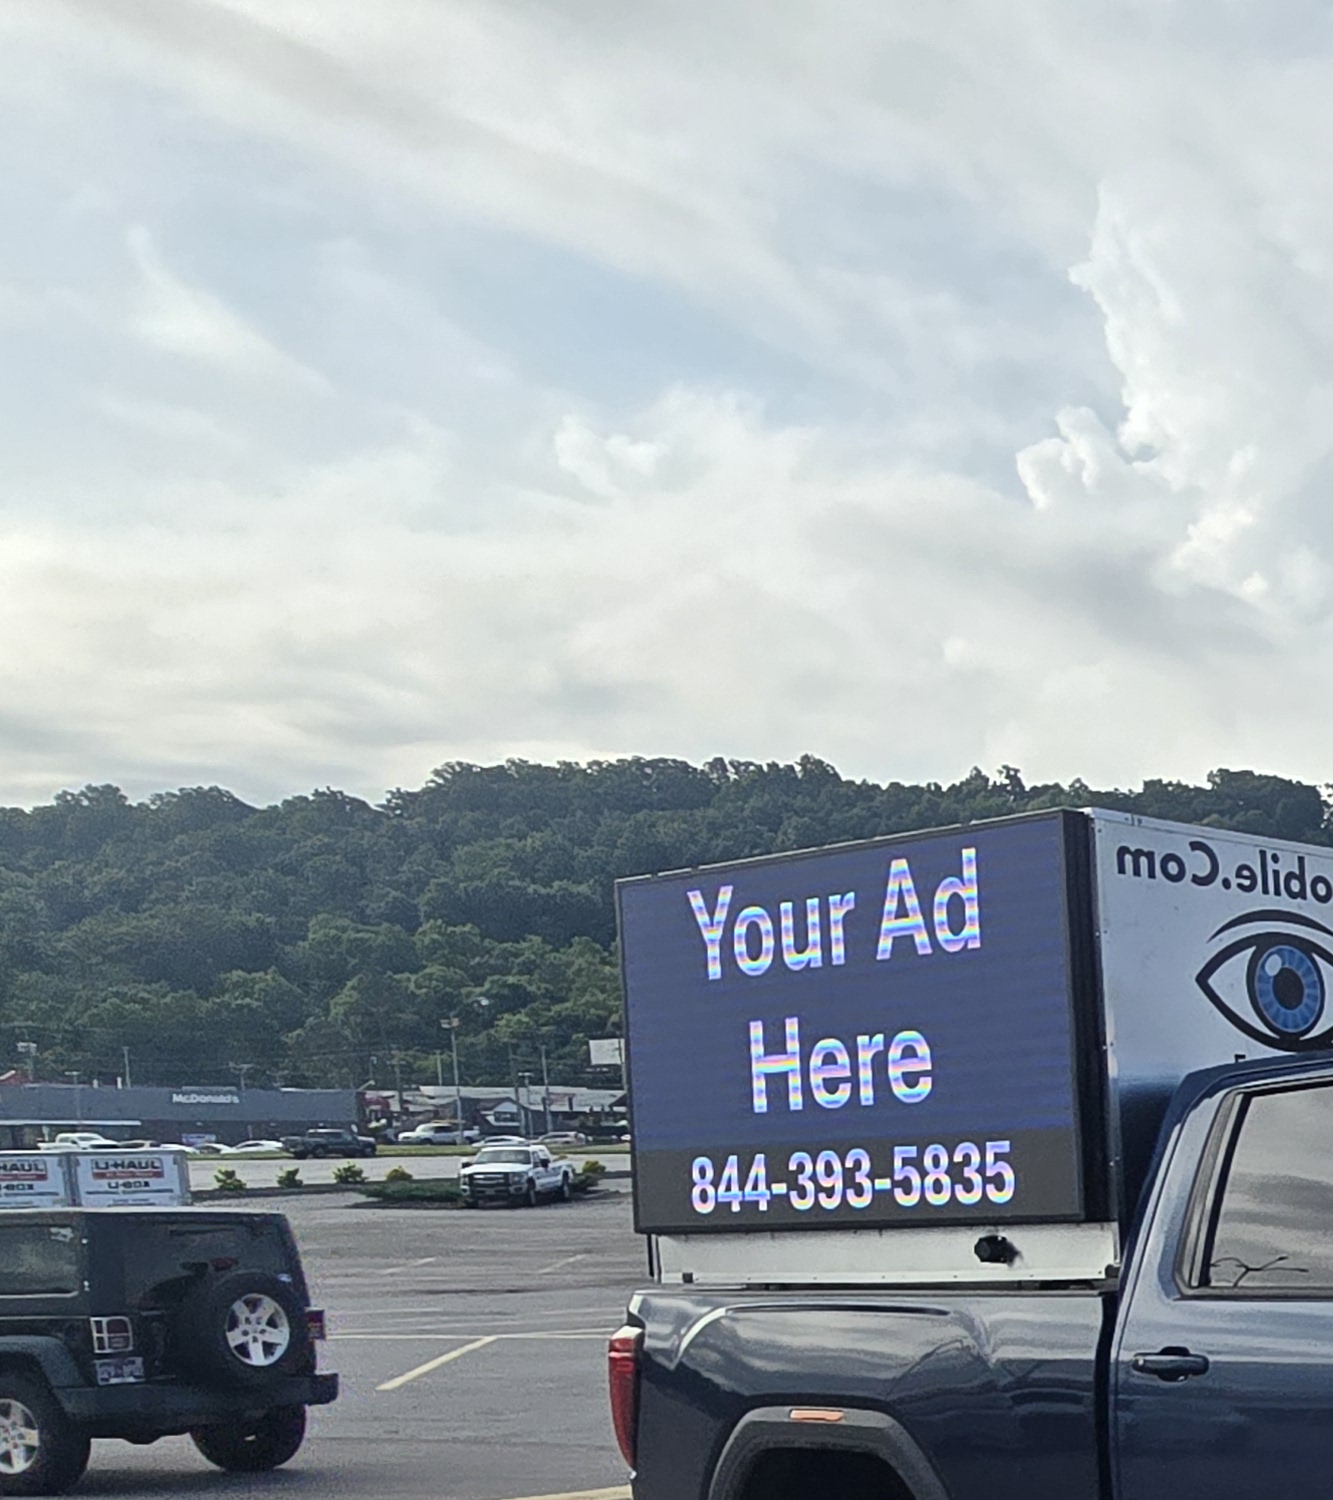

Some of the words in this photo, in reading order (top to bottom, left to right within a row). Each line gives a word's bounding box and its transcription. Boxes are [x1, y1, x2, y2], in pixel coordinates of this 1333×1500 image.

[687, 885, 855, 980] Your
[876, 847, 982, 961] Ad
[749, 1016, 933, 1113] Here
[94, 1159, 160, 1170] U-HAUL
[692, 1140, 1016, 1213] 844-393-5835
